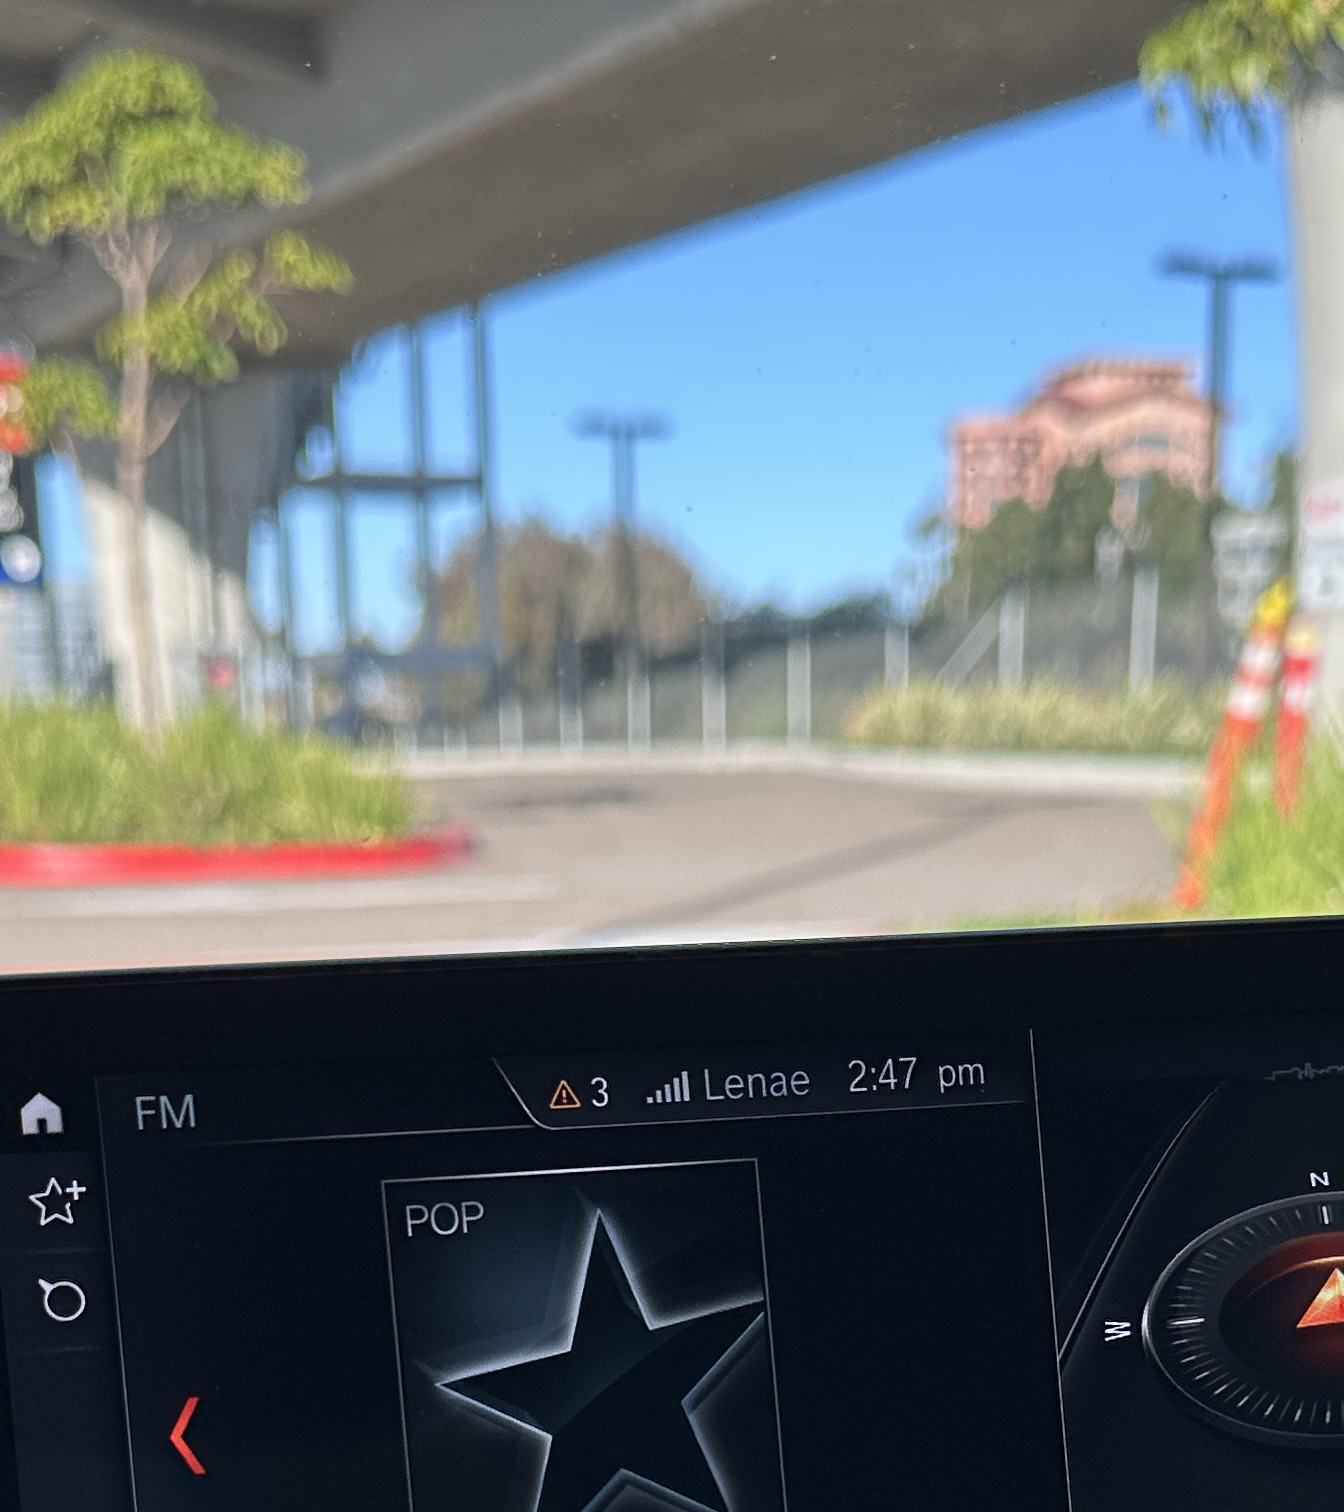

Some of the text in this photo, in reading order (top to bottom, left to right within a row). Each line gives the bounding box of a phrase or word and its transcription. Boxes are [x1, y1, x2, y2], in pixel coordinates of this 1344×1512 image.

[704, 1068, 810, 1101] Lenae
[848, 1056, 985, 1093] 2:47 pm
[590, 1076, 609, 1107] 3
[135, 1093, 196, 1130] FM
[1309, 1171, 1330, 1188] N
[405, 1201, 484, 1237] POP
[1104, 1321, 1132, 1342] W
